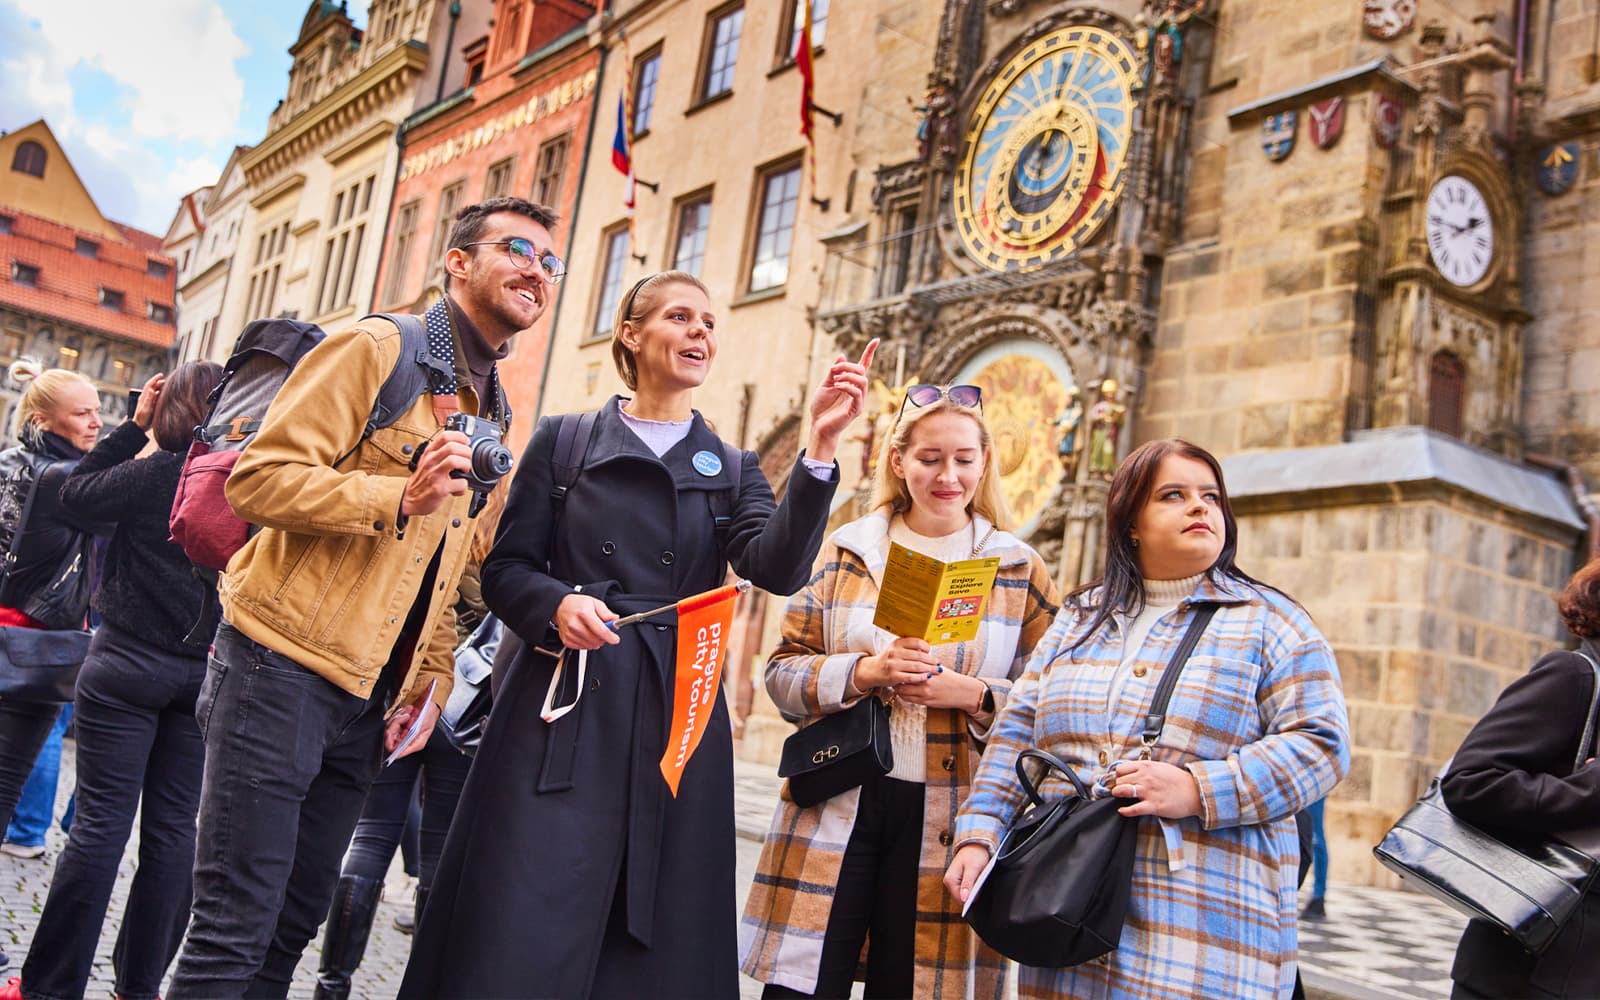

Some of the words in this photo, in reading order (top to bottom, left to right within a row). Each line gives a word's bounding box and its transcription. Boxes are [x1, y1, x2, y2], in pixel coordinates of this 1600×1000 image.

[692, 628, 709, 671] city
[702, 622, 721, 705] prague
[675, 676, 704, 768] tourism
